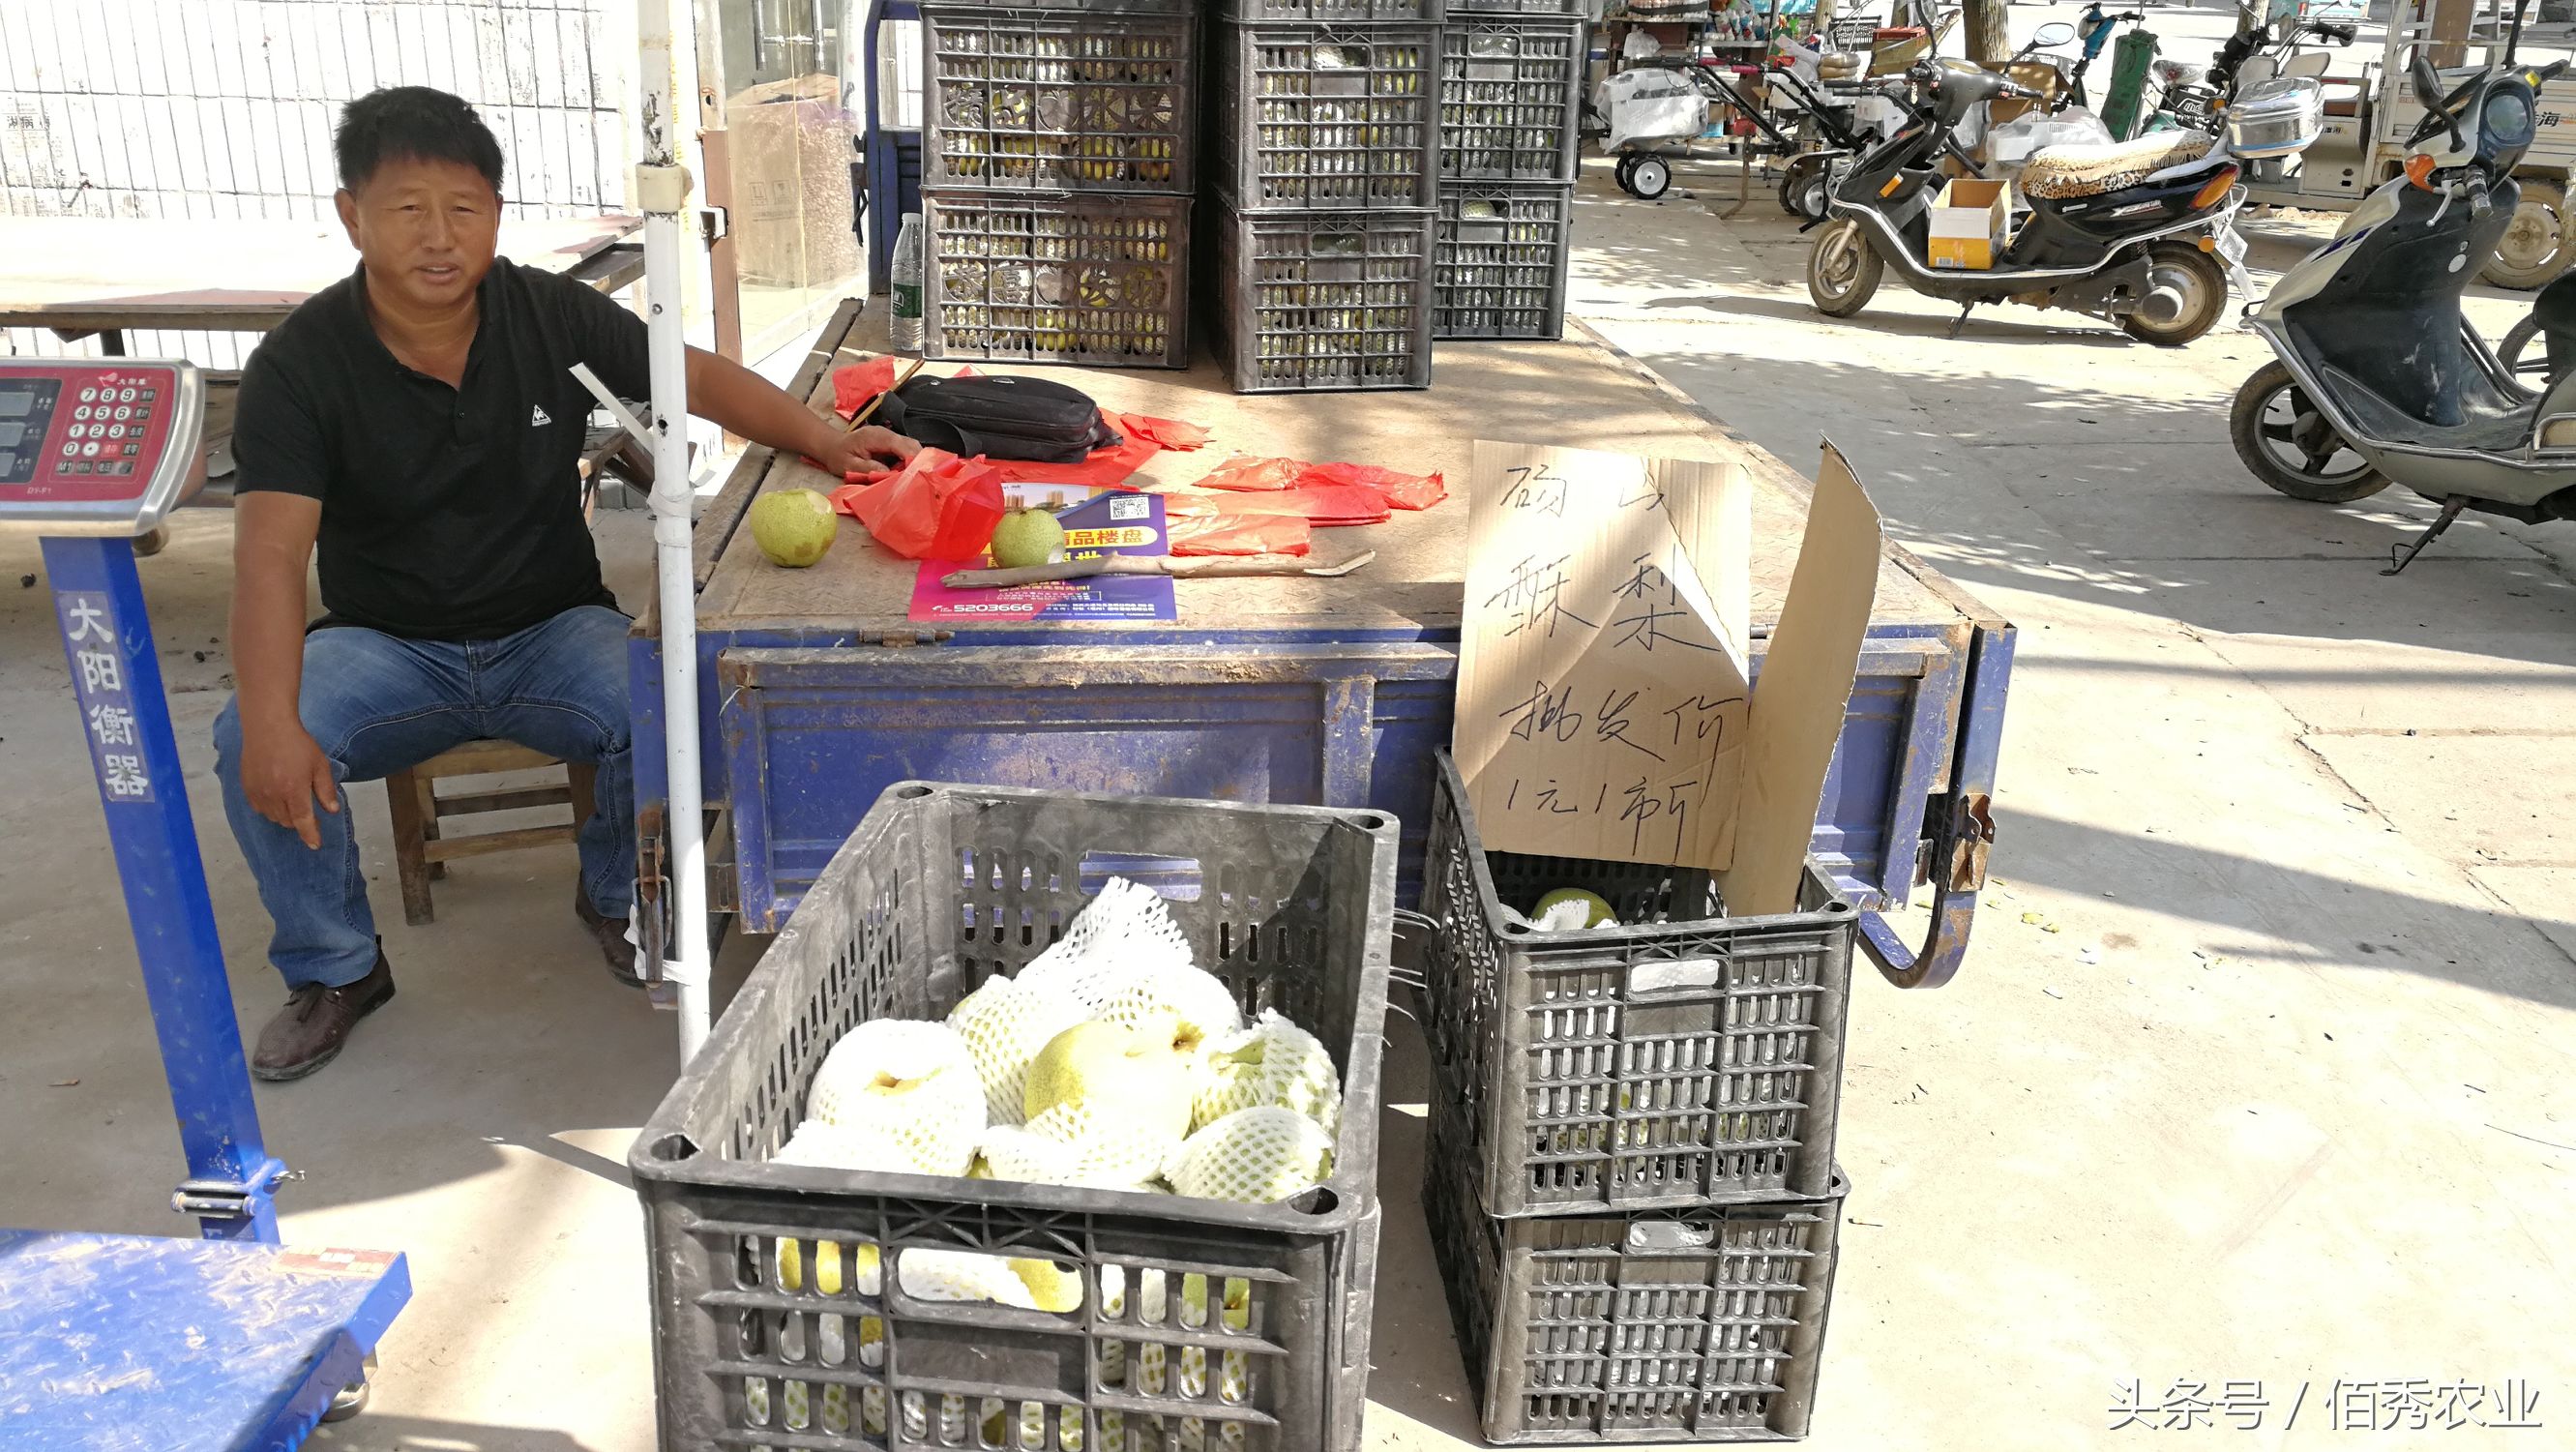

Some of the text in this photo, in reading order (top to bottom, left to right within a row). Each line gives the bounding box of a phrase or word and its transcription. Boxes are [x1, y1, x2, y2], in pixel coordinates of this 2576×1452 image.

[1064, 528, 1143, 546] 品楼盘
[953, 604, 1034, 612] 5203666
[1483, 543, 1722, 652] 酥梨
[69, 598, 148, 795] 大阳衡器
[1498, 680, 1744, 810] 批发价
